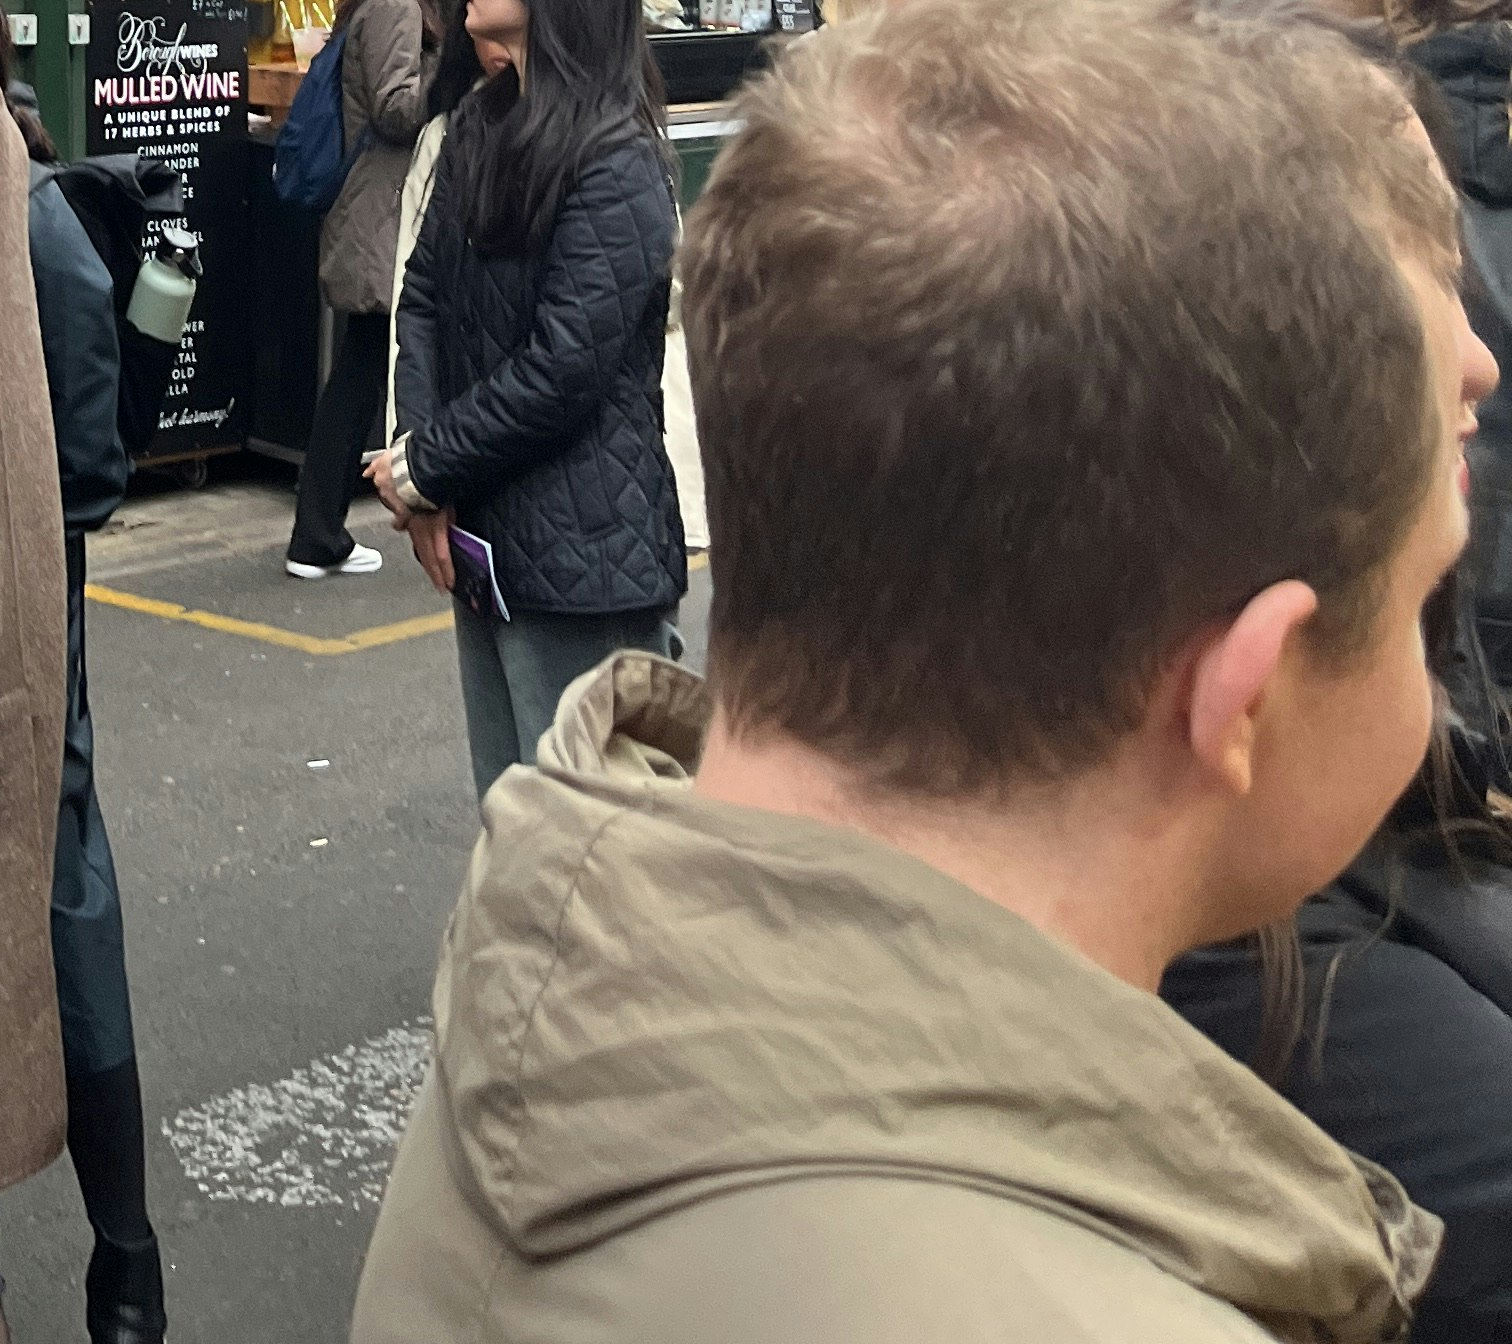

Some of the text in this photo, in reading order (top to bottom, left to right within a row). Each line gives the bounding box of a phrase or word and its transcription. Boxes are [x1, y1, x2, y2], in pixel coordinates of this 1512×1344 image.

[181, 44, 218, 59] WINES
[94, 70, 240, 107] MULLED WINE
[104, 105, 231, 125] A UNIQUE BLEND OF
[105, 120, 221, 140] 17 HERBS & SPICES
[137, 142, 199, 158] CINNAMON
